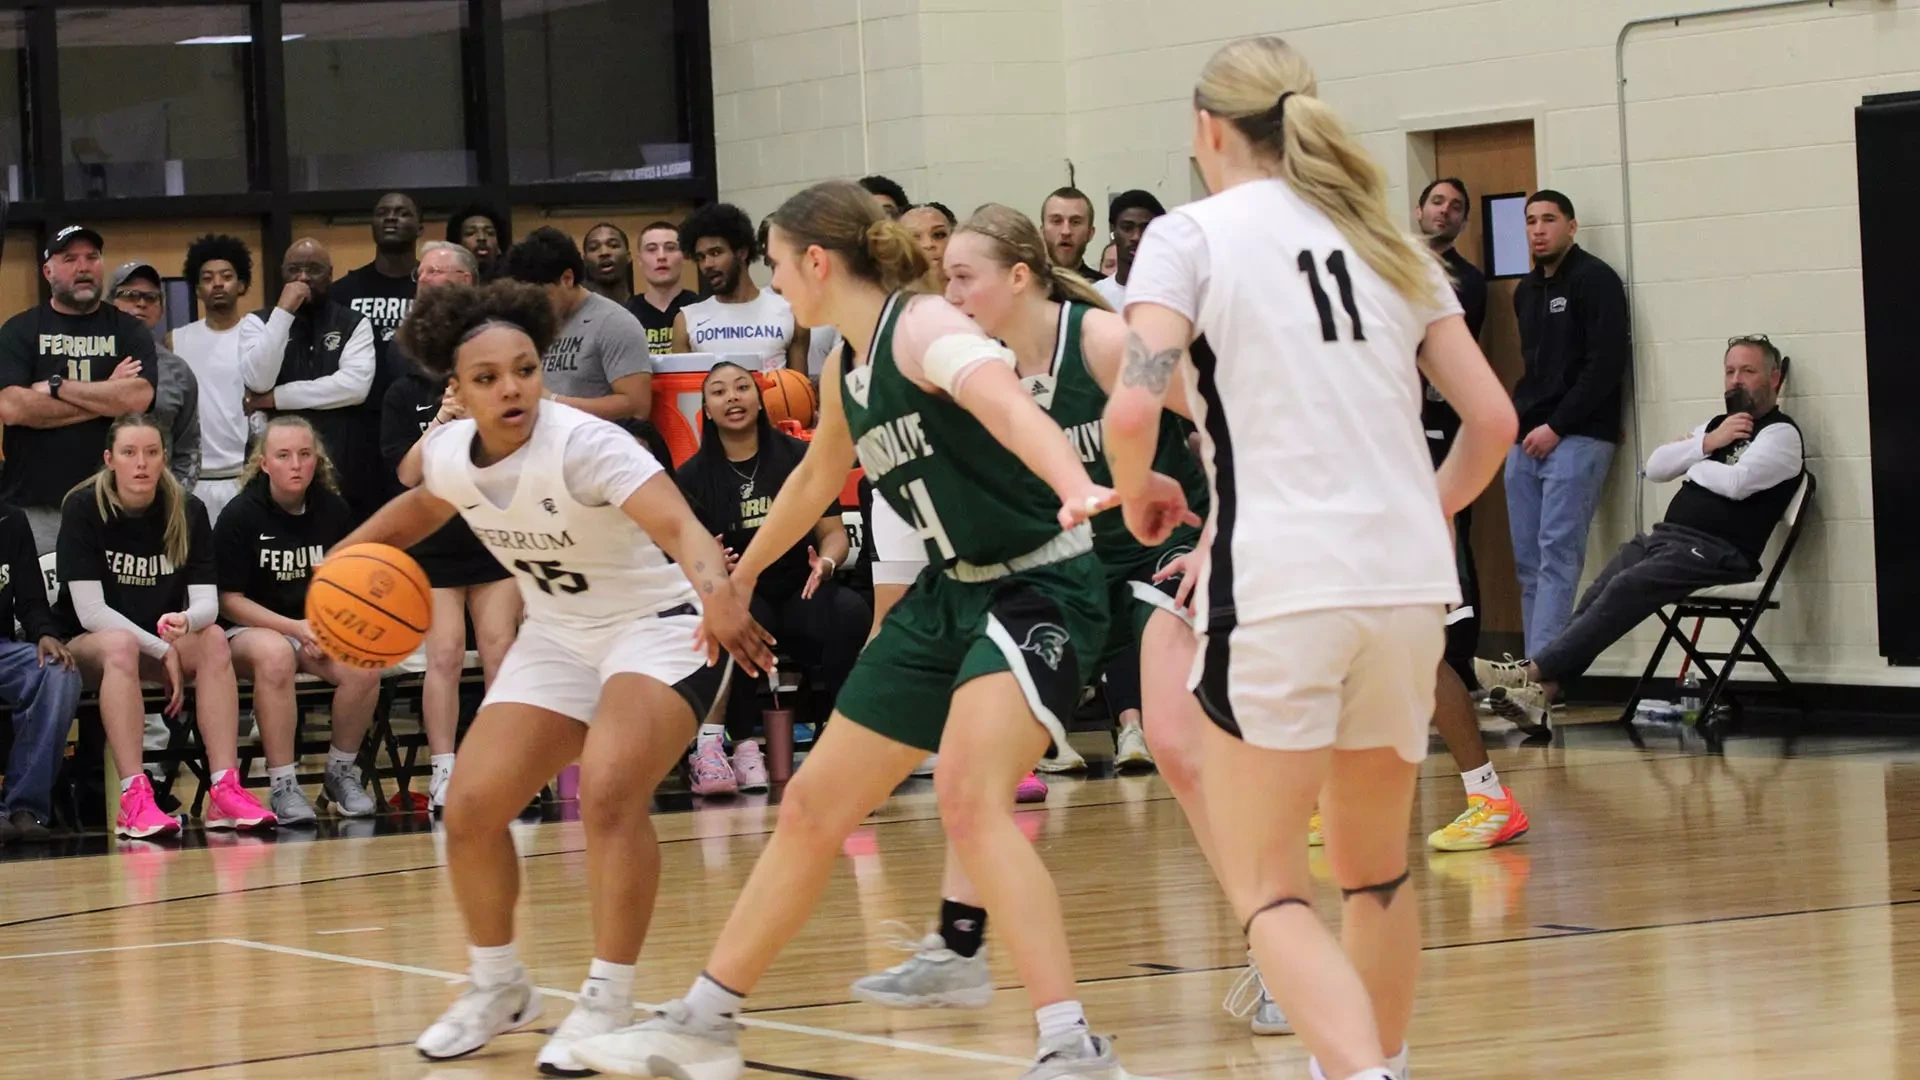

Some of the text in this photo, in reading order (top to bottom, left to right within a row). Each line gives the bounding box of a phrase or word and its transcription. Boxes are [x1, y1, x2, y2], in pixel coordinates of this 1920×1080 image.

[1297, 249, 1367, 342] 11
[350, 297, 415, 319] FERRU
[39, 333, 116, 357] FERRUM
[696, 325, 784, 344] DOMINICANA
[67, 359, 91, 383] 11
[473, 527, 577, 550] FERRUM
[105, 550, 175, 578] FERRUM
[117, 574, 157, 586] PANTHERS
[513, 559, 589, 596] 15
